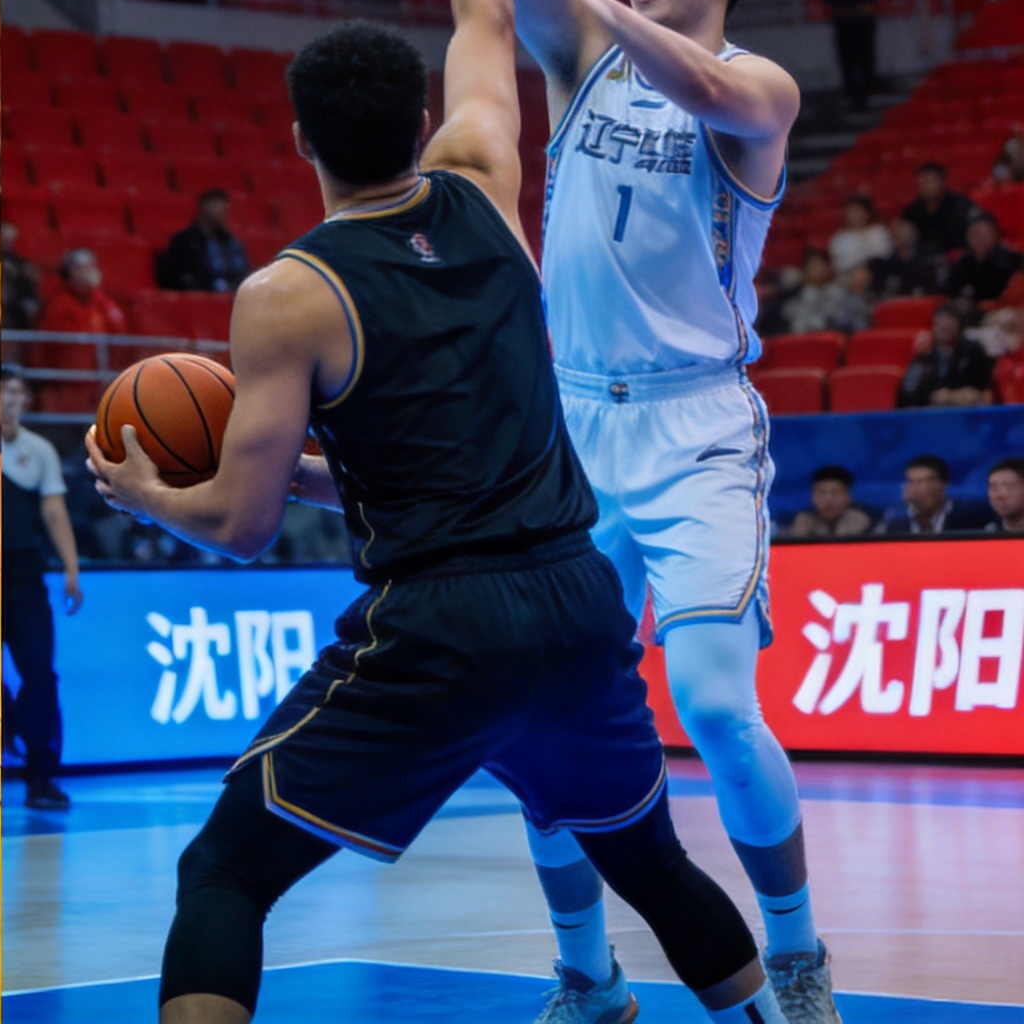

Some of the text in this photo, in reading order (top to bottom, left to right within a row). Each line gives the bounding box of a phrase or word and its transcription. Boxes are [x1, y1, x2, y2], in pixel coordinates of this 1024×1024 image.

[613, 185, 632, 242] 1
[146, 606, 316, 724] 沈阳
[792, 583, 1024, 716] 沈阳
